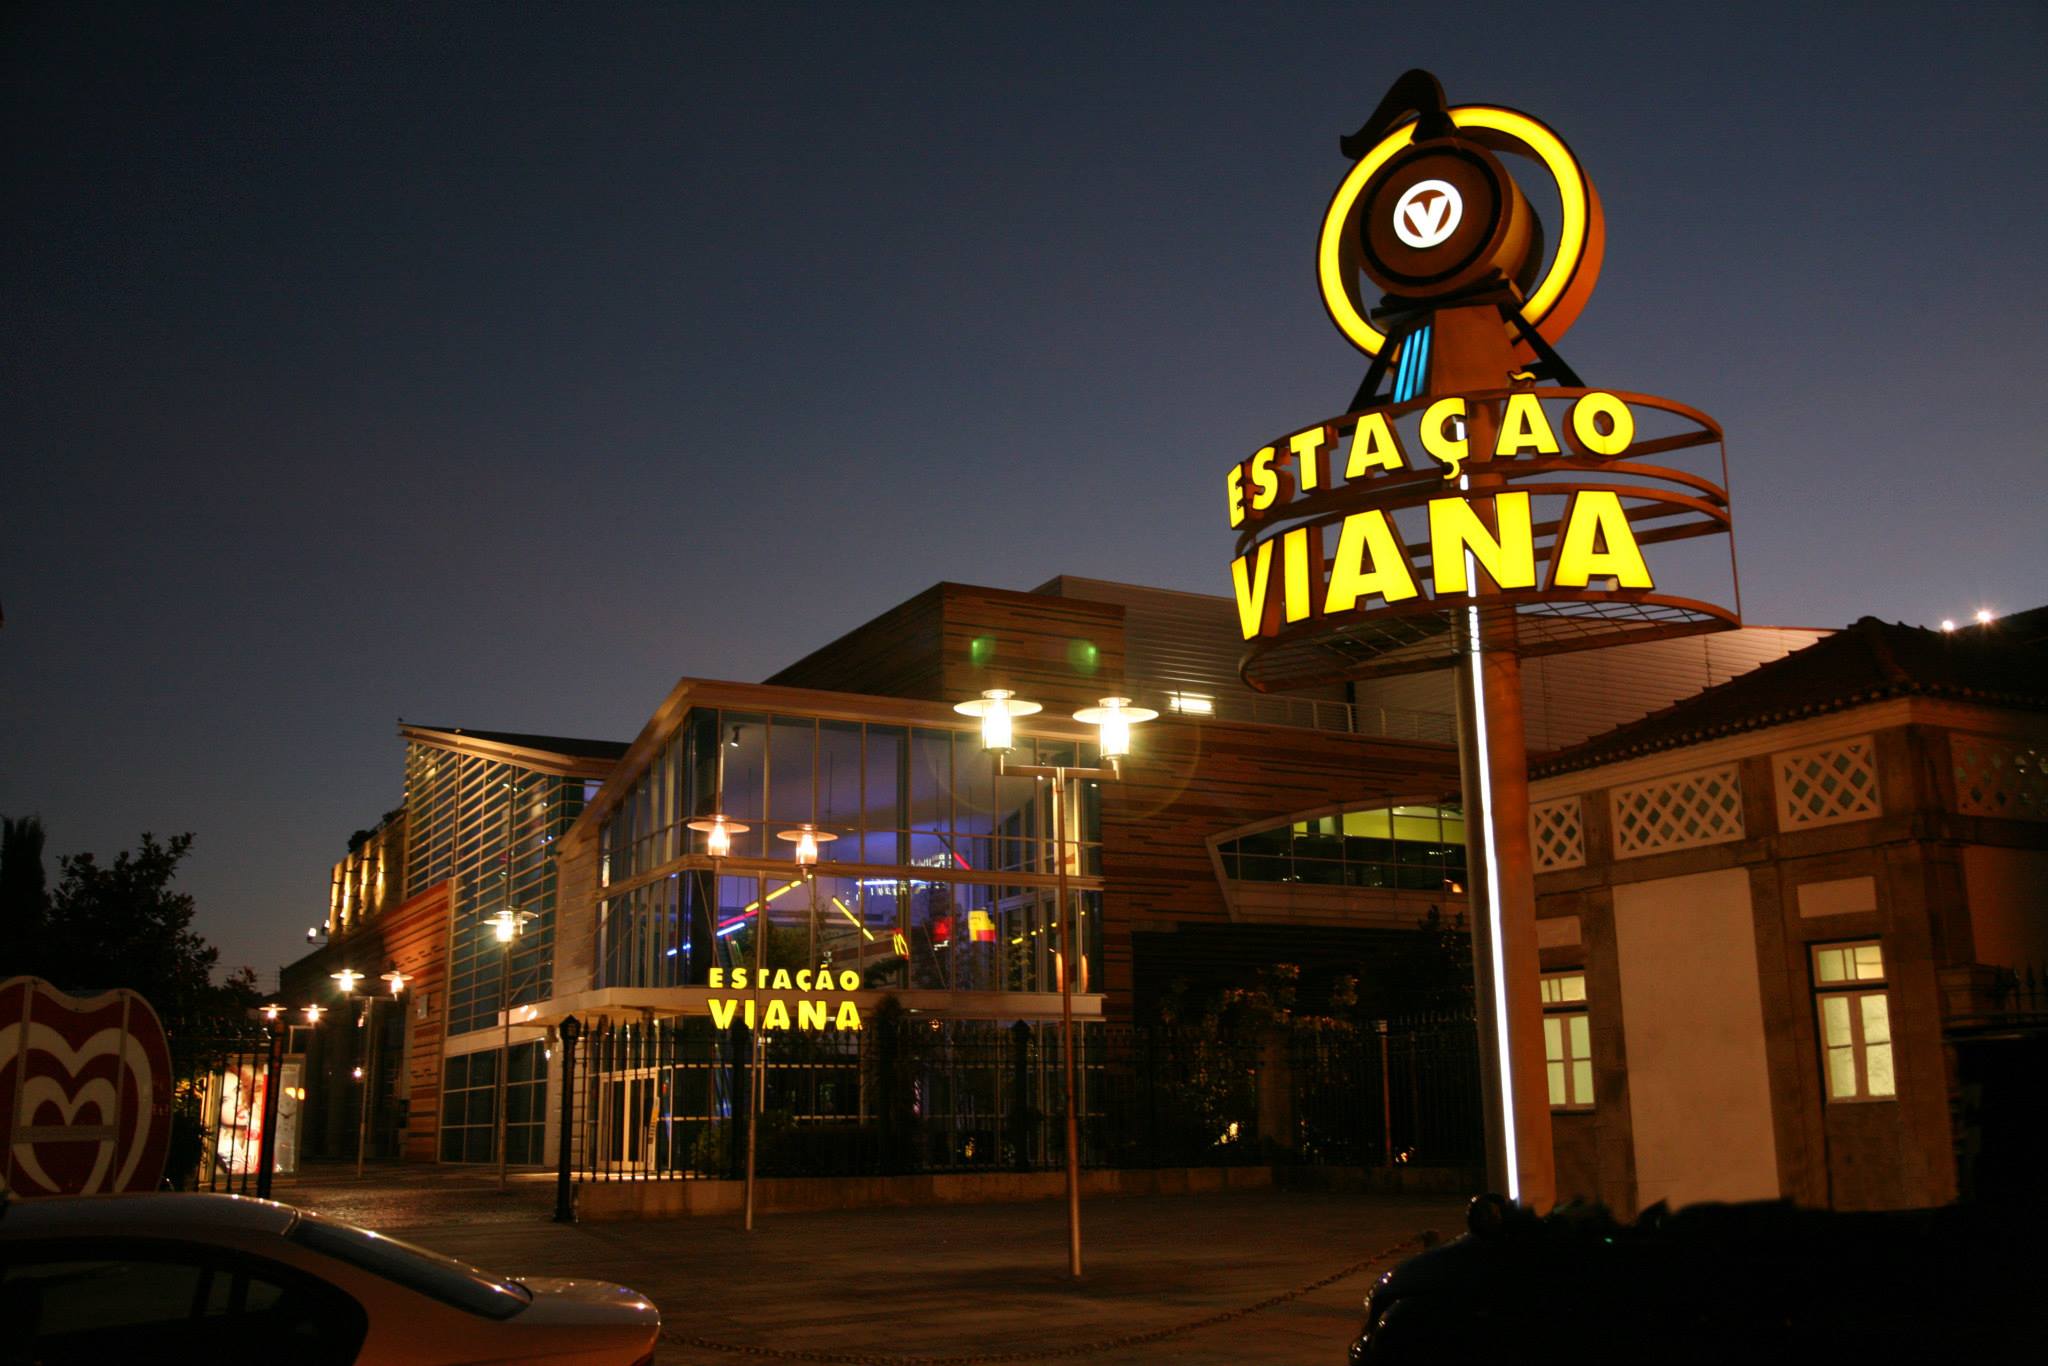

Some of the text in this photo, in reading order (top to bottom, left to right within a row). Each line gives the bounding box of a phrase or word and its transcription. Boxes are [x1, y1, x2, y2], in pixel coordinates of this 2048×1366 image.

[1402, 192, 1452, 242] V
[1227, 371, 1634, 528] ESTAÇÃO
[1231, 491, 1655, 641] VIANA
[709, 964, 860, 992] ESTAÇÃO
[707, 999, 862, 1030] VIANA
